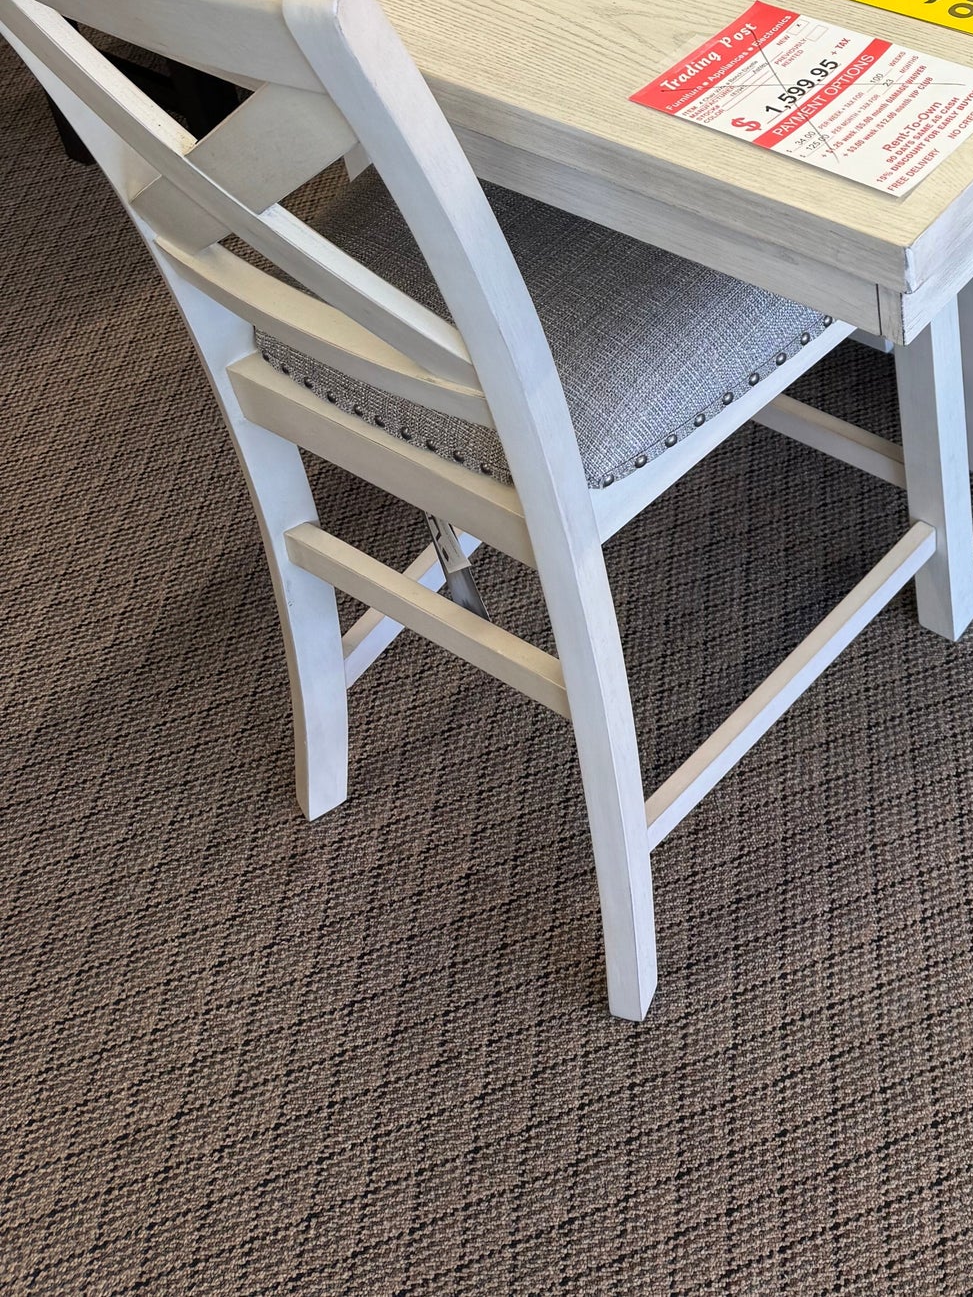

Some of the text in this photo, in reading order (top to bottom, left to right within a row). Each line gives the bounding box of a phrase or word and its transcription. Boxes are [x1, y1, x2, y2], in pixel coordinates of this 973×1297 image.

[660, 50, 722, 91] Trading
[719, 21, 757, 48] Post
[707, 52, 749, 82] Appliances
[752, 14, 792, 48] Electronics
[774, 38, 808, 65] PREVIOUSLY
[776, 34, 791, 46] NEW
[781, 49, 804, 68] RENTED
[889, 51, 907, 67] WEEKS
[899, 55, 920, 74] MONTHS
[731, 117, 762, 132] $
[765, 59, 839, 113] 1,599.95
[835, 37, 851, 50] TAX
[772, 54, 875, 136] PAYMENT OPTIONS
[842, 129, 859, 144] week
[871, 103, 889, 119] month
[886, 83, 910, 105] DAMAGE
[906, 64, 928, 87] WAIVER
[864, 126, 879, 141] week
[894, 97, 912, 114] month
[908, 87, 921, 100] VIP
[918, 76, 934, 91] CLUB
[876, 169, 894, 184] 15%
[891, 141, 927, 172] DISCOUNT
[925, 129, 941, 143] FOR
[938, 109, 962, 131] EARLY
[881, 100, 943, 152] Rent-To-Own
[886, 96, 960, 164] 90 DAYS SAME AS CASH
[887, 174, 909, 192] FREE
[906, 148, 941, 178] DELIVERY
[947, 127, 962, 140] NO
